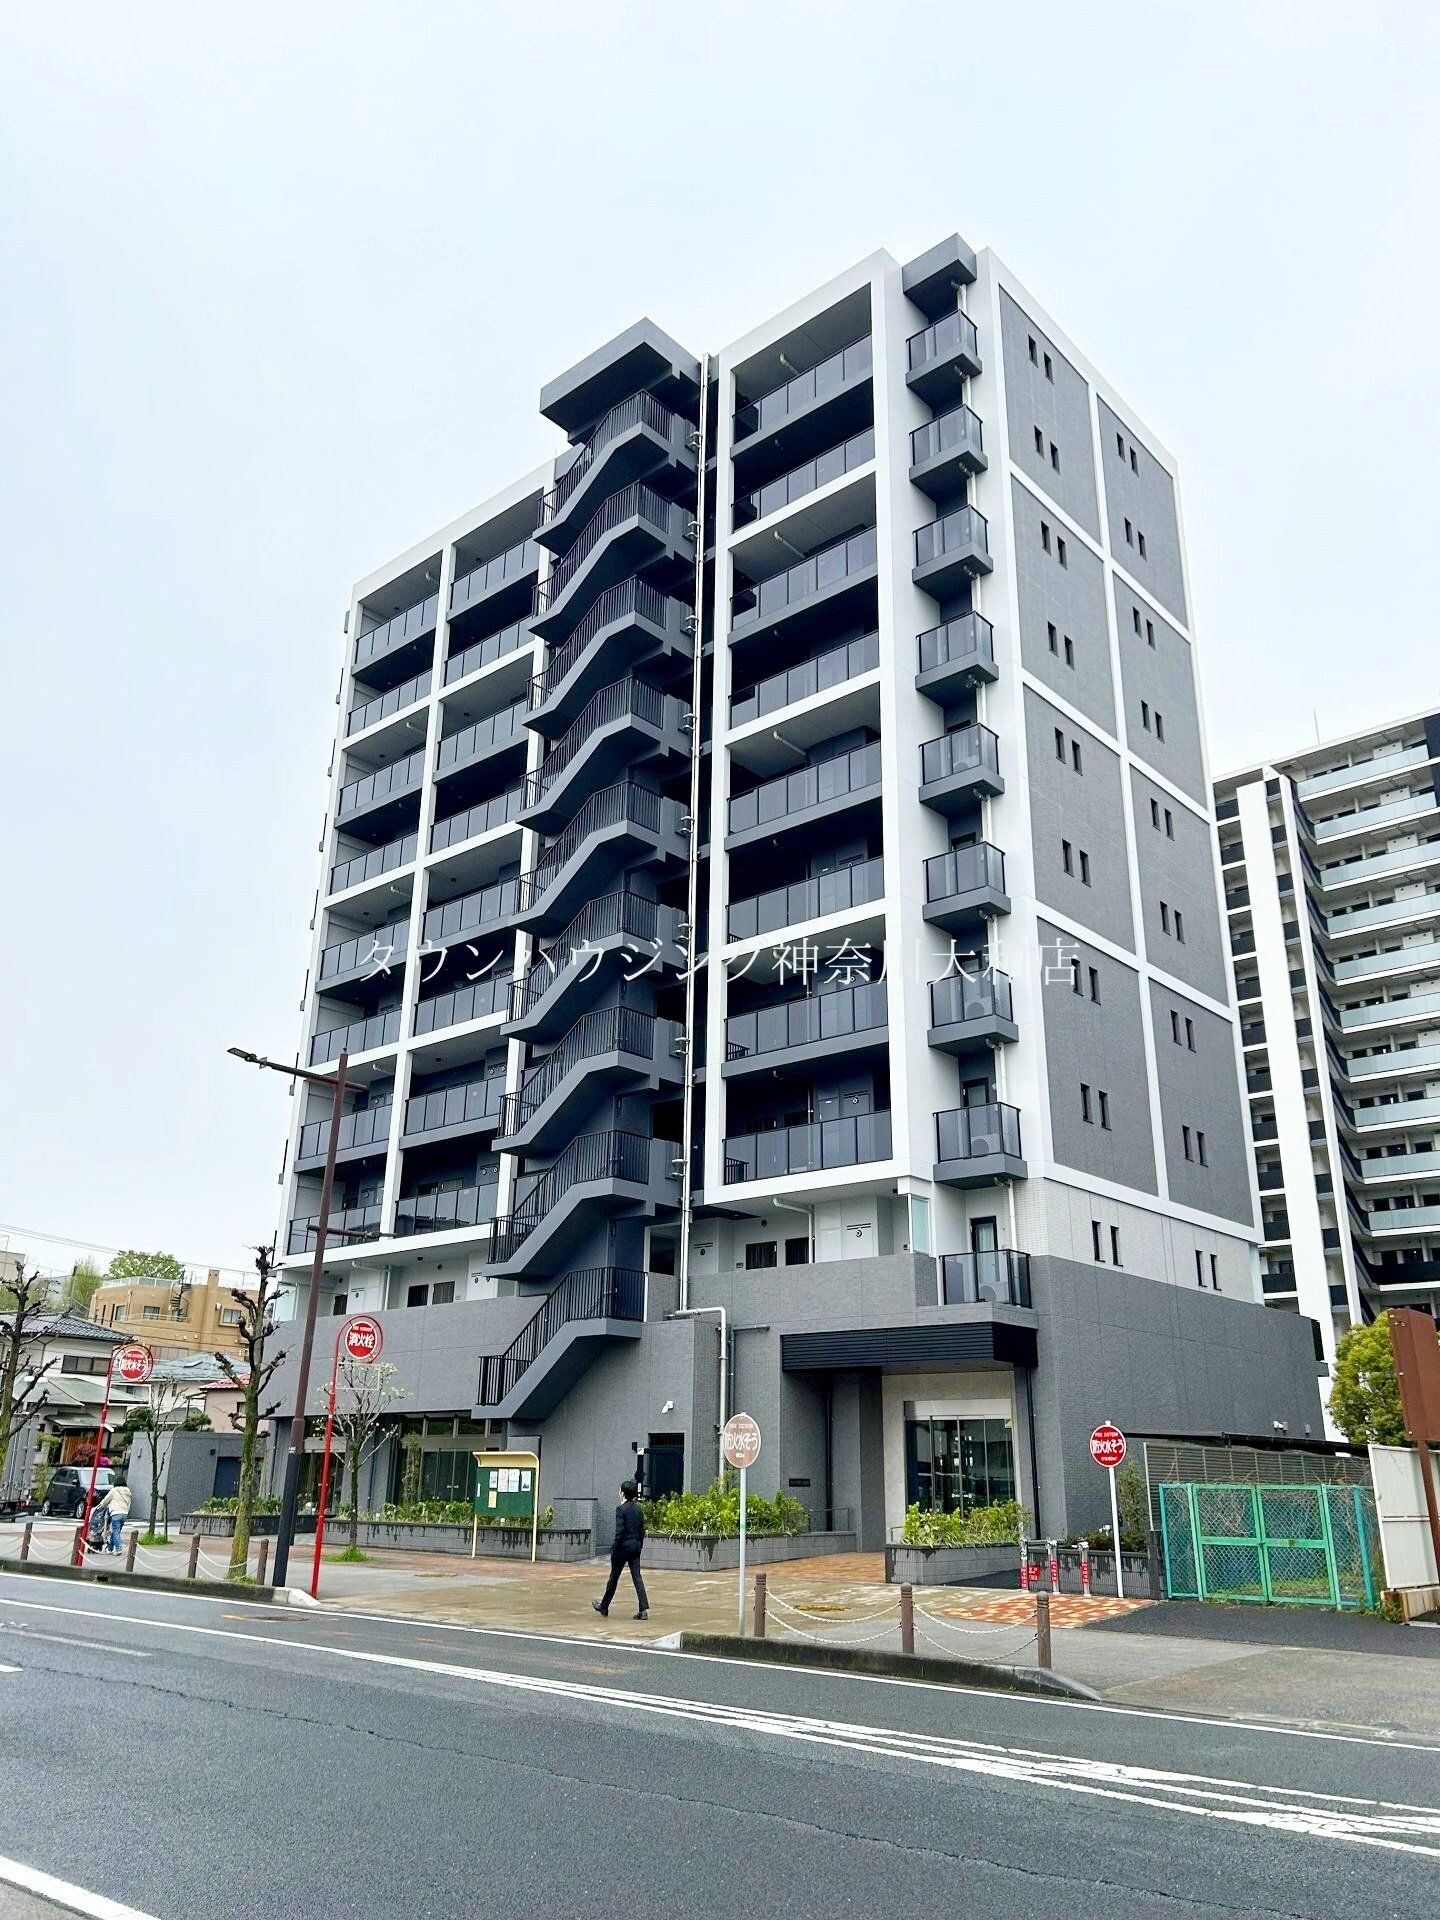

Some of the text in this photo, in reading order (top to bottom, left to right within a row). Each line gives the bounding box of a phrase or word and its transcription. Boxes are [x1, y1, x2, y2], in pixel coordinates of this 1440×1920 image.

[349, 1332, 374, 1348] 消火栓
[726, 1432, 758, 1450] 防火水そう
[1092, 1439, 1124, 1454] 防火水そう
